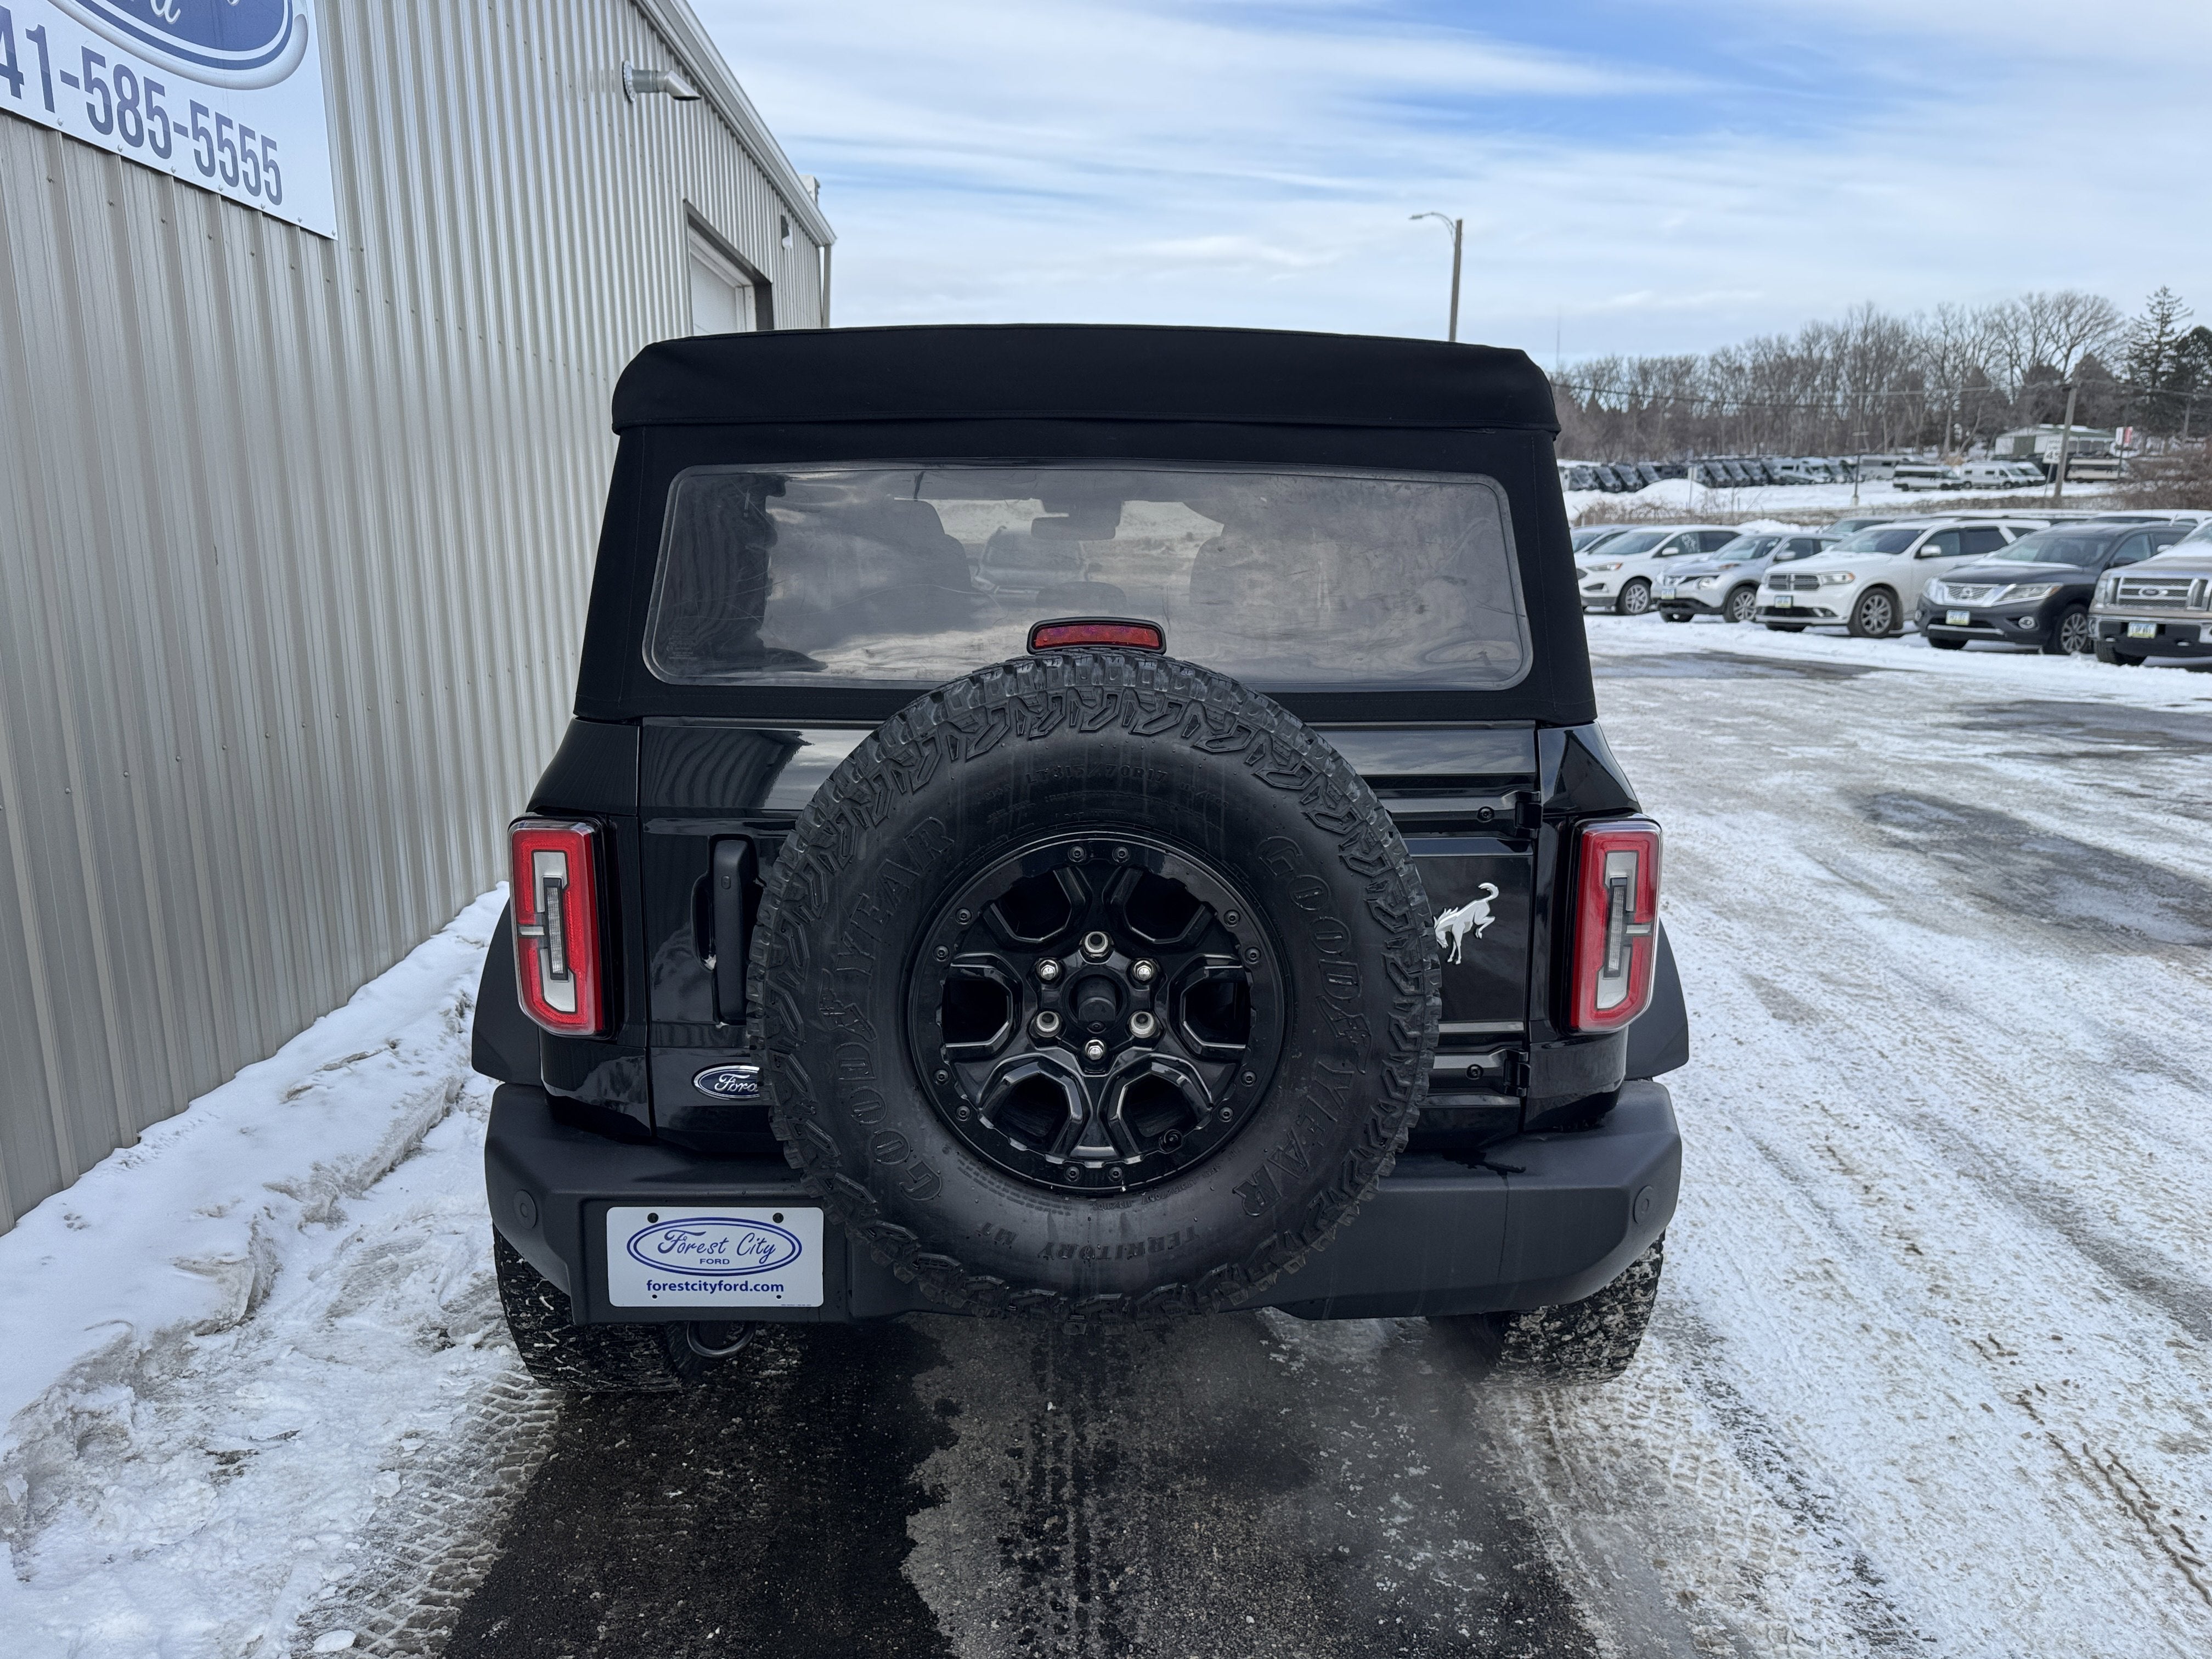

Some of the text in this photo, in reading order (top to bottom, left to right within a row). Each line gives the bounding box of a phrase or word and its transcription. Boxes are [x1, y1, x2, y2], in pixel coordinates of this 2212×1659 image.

[657, 1229, 776, 1264] Forest City
[975, 1222, 1200, 1261] TERRITORY MT
[646, 1279, 785, 1294] forestcityford.com
